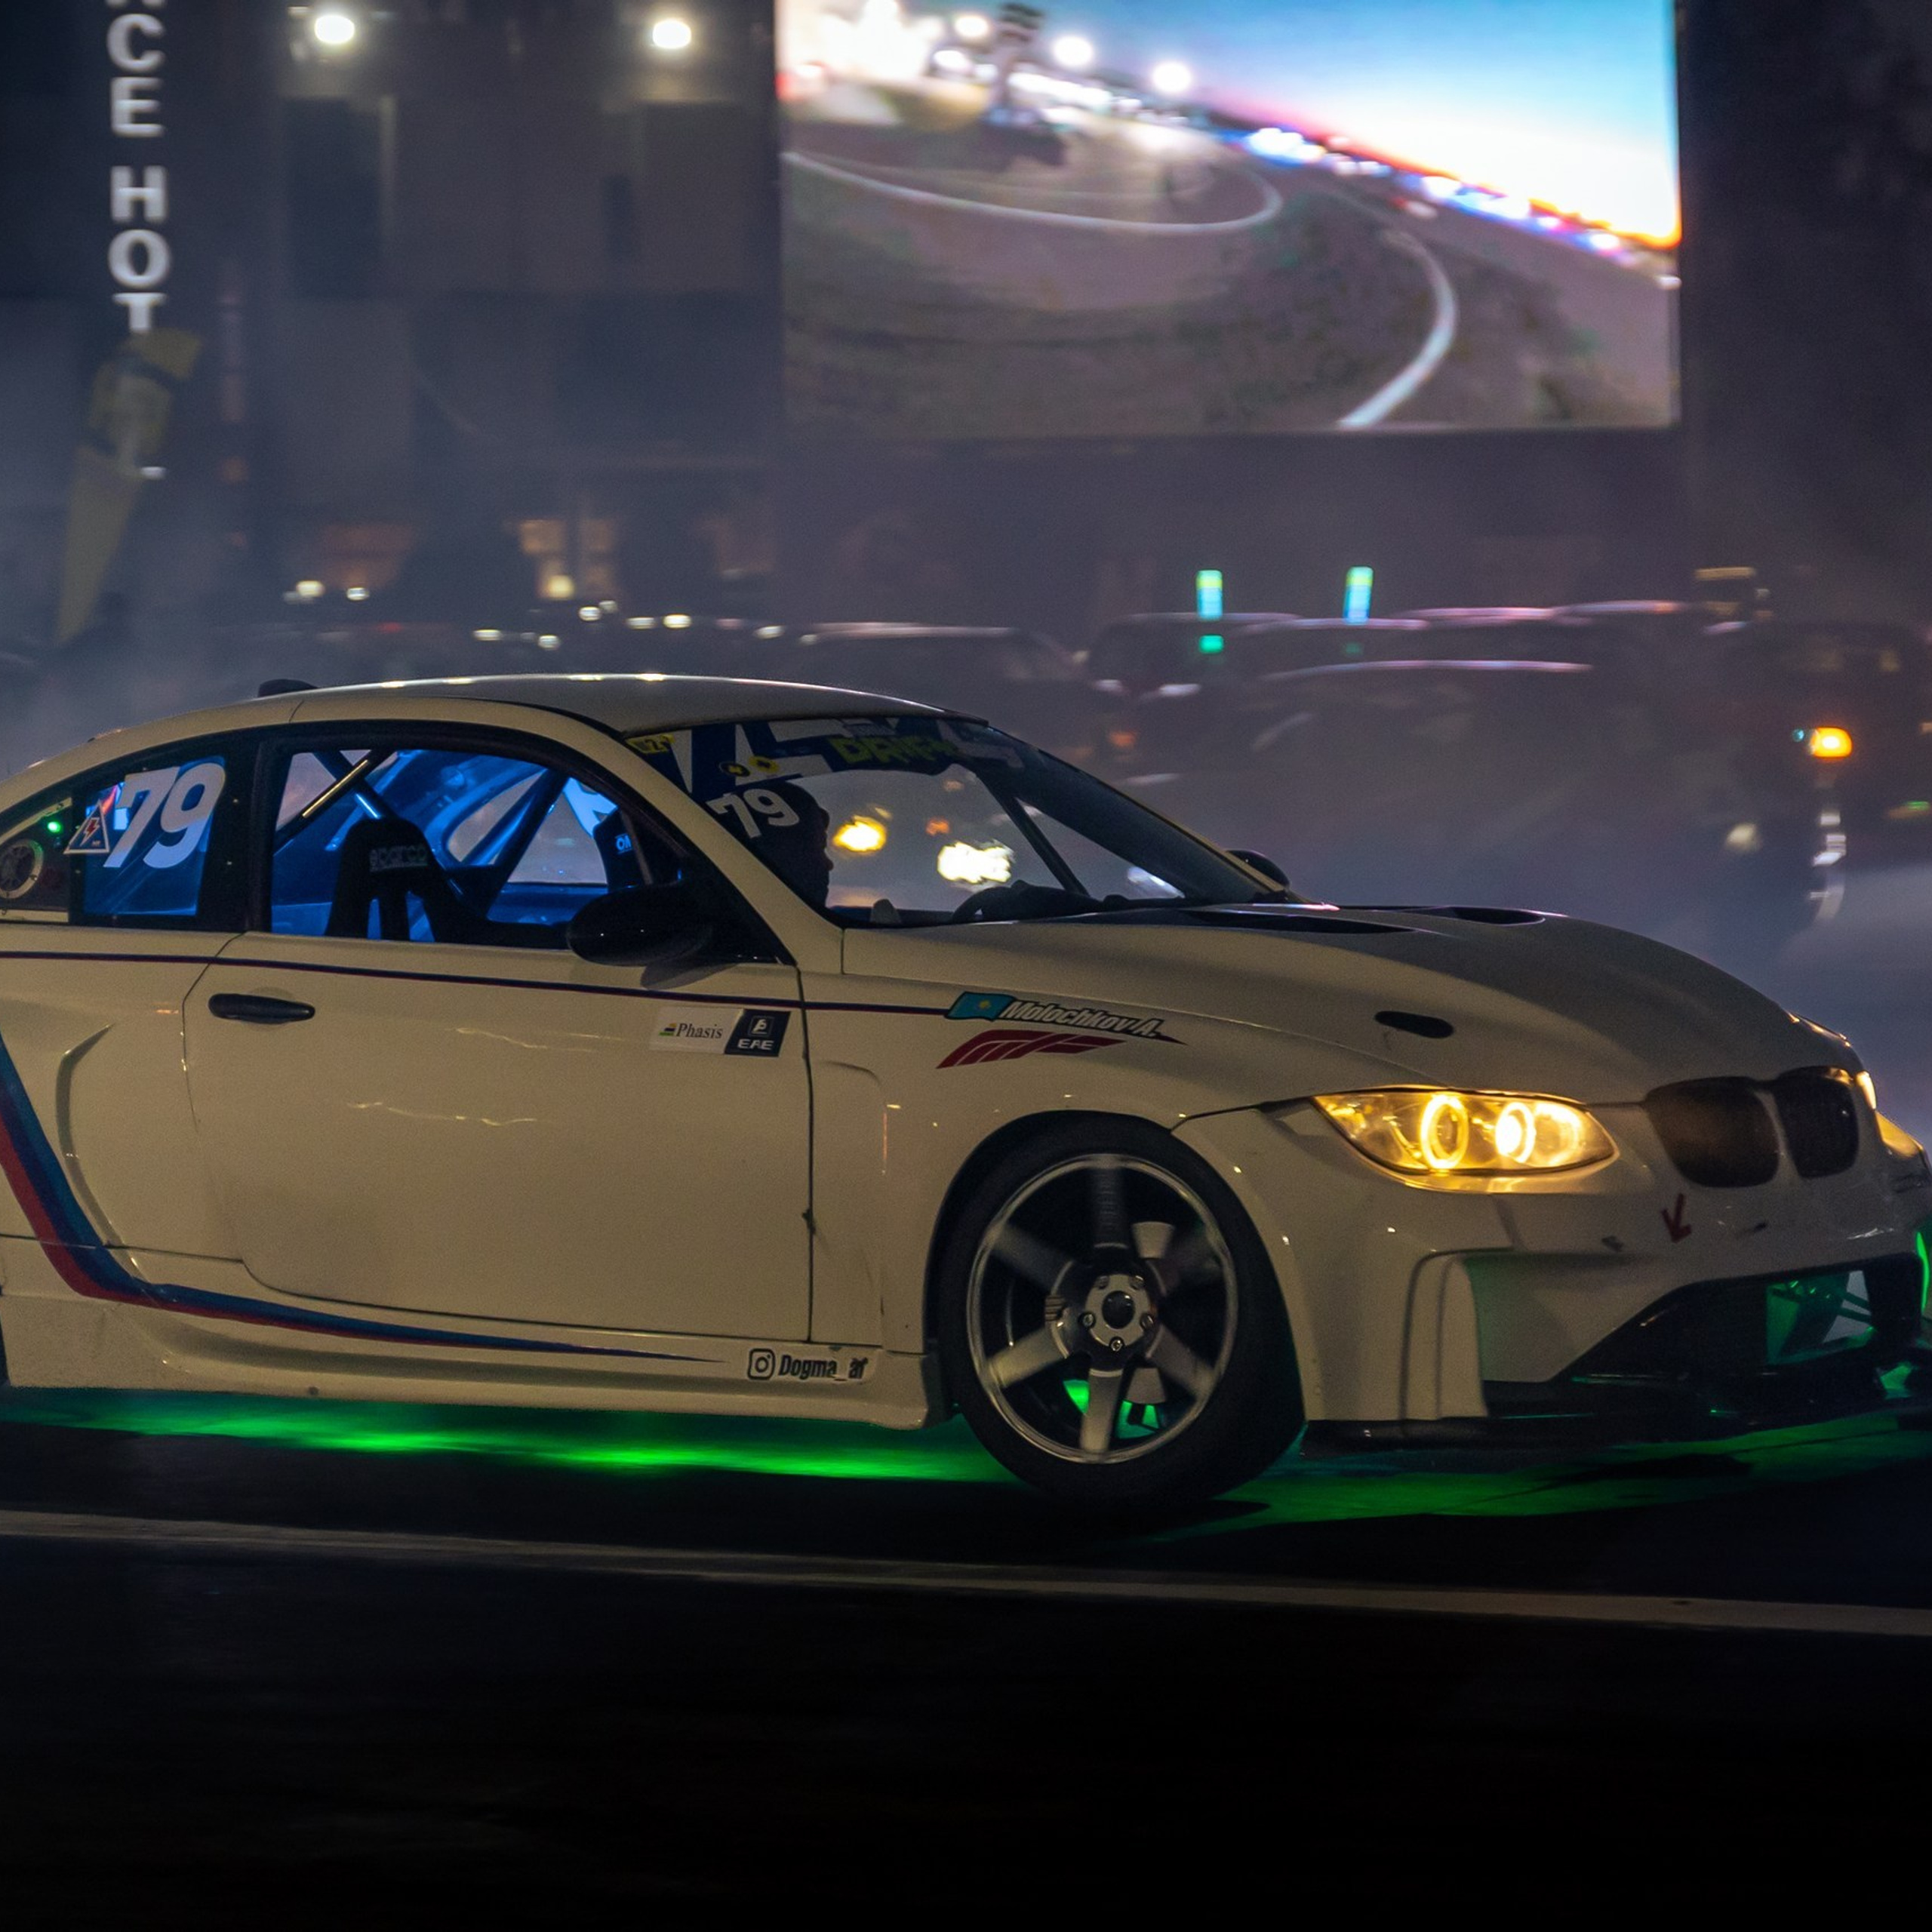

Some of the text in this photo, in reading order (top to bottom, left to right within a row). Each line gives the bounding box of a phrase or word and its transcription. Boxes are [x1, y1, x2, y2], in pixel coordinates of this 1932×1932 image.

[106, 0, 166, 138] CE
[103, 762, 226, 869] 79
[706, 789, 800, 838] 79
[675, 1023, 724, 1039] Phasis
[998, 1001, 1164, 1037] Molochkov A.
